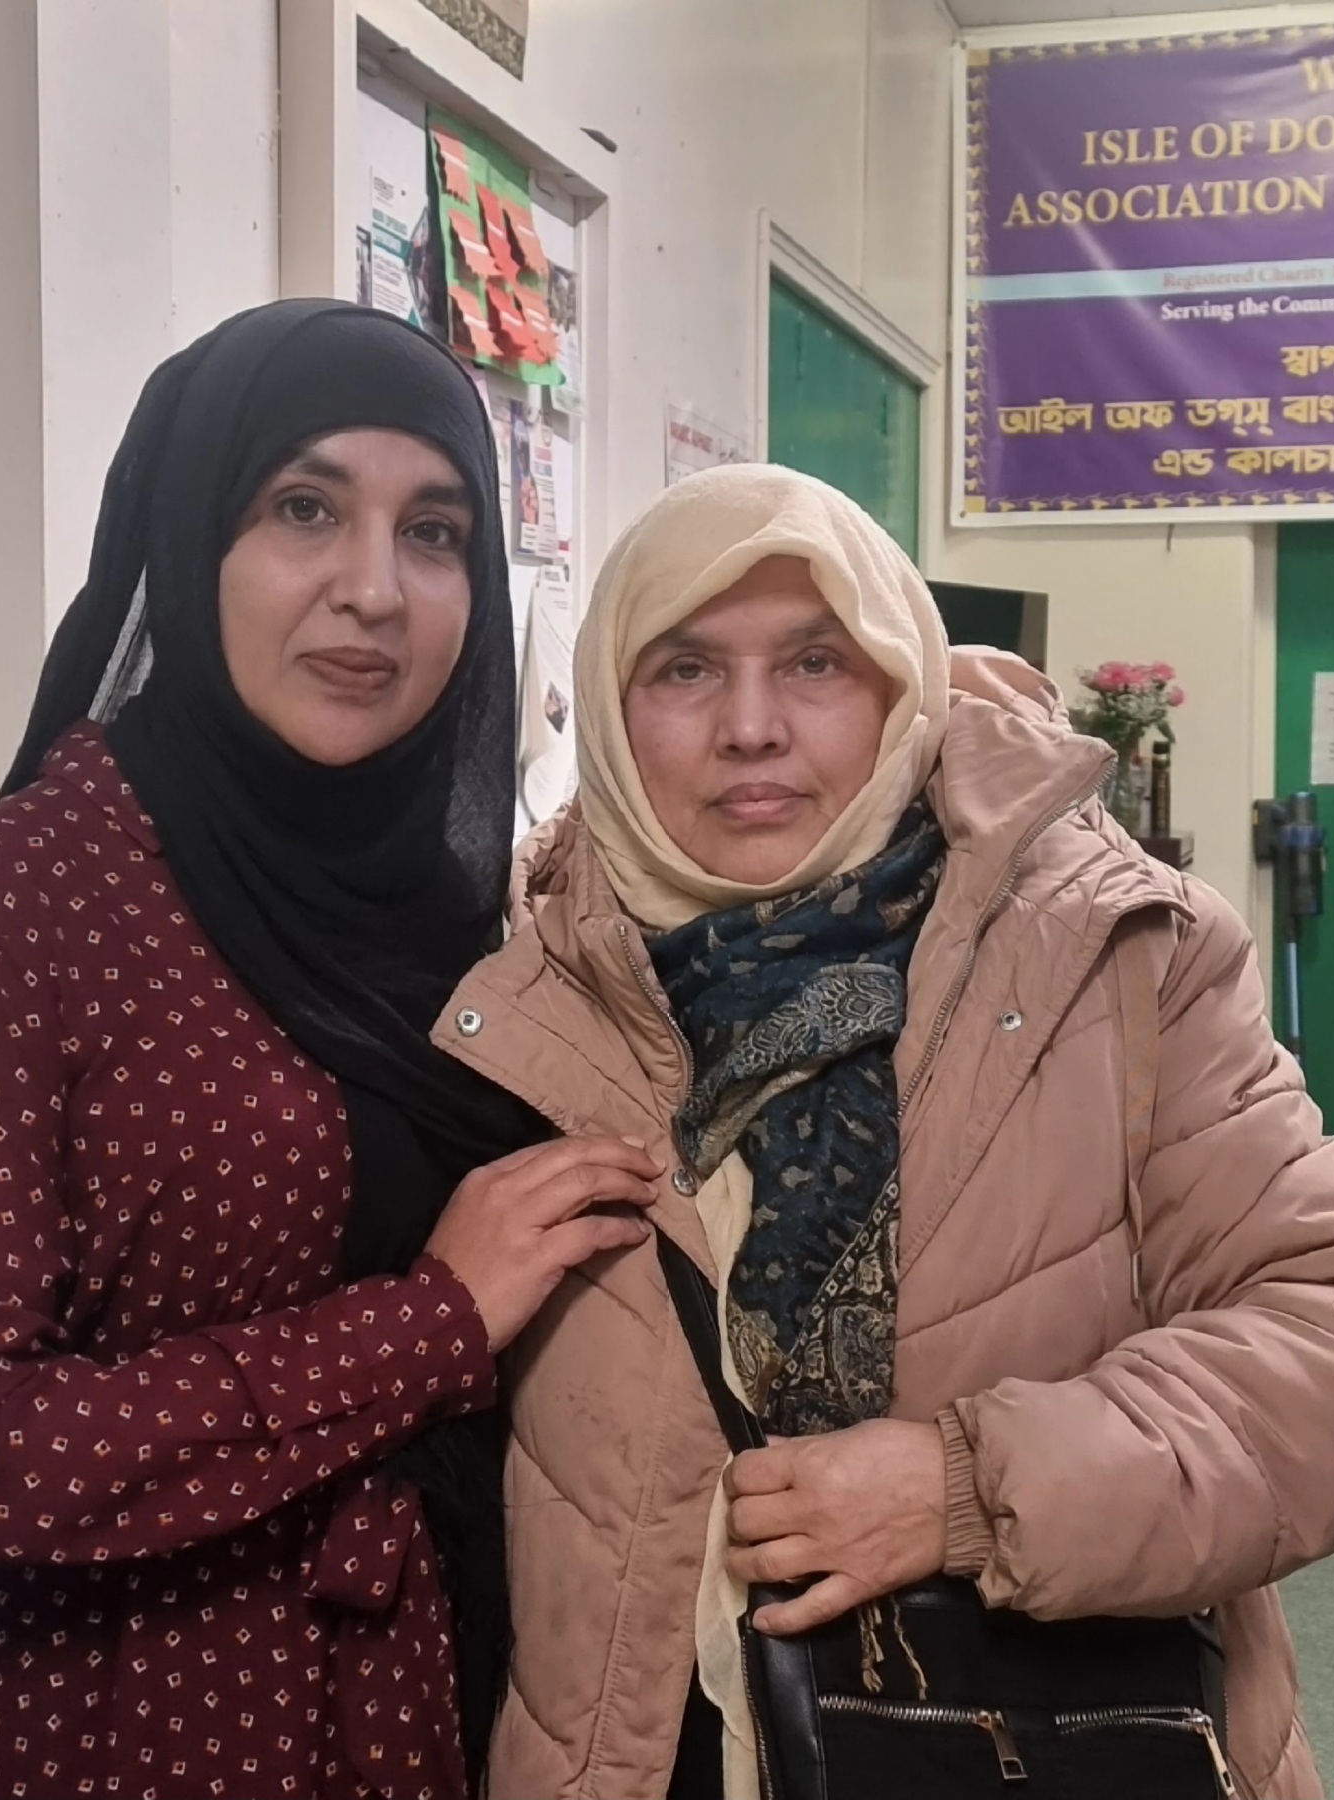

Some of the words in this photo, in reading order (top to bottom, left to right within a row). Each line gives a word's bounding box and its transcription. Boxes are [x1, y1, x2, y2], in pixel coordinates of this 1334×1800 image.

[1082, 125, 1180, 165] ISLE
[1190, 120, 1256, 160] OF
[1003, 173, 1326, 227] ASSOCIATION
[1162, 264, 1254, 291] Registered
[1258, 261, 1326, 285] Charity
[1161, 300, 1235, 322] Serving
[1238, 297, 1269, 316] the
[997, 397, 1093, 434] আইল
[1104, 400, 1175, 430] অফ
[1153, 447, 1216, 477] এন্ড
